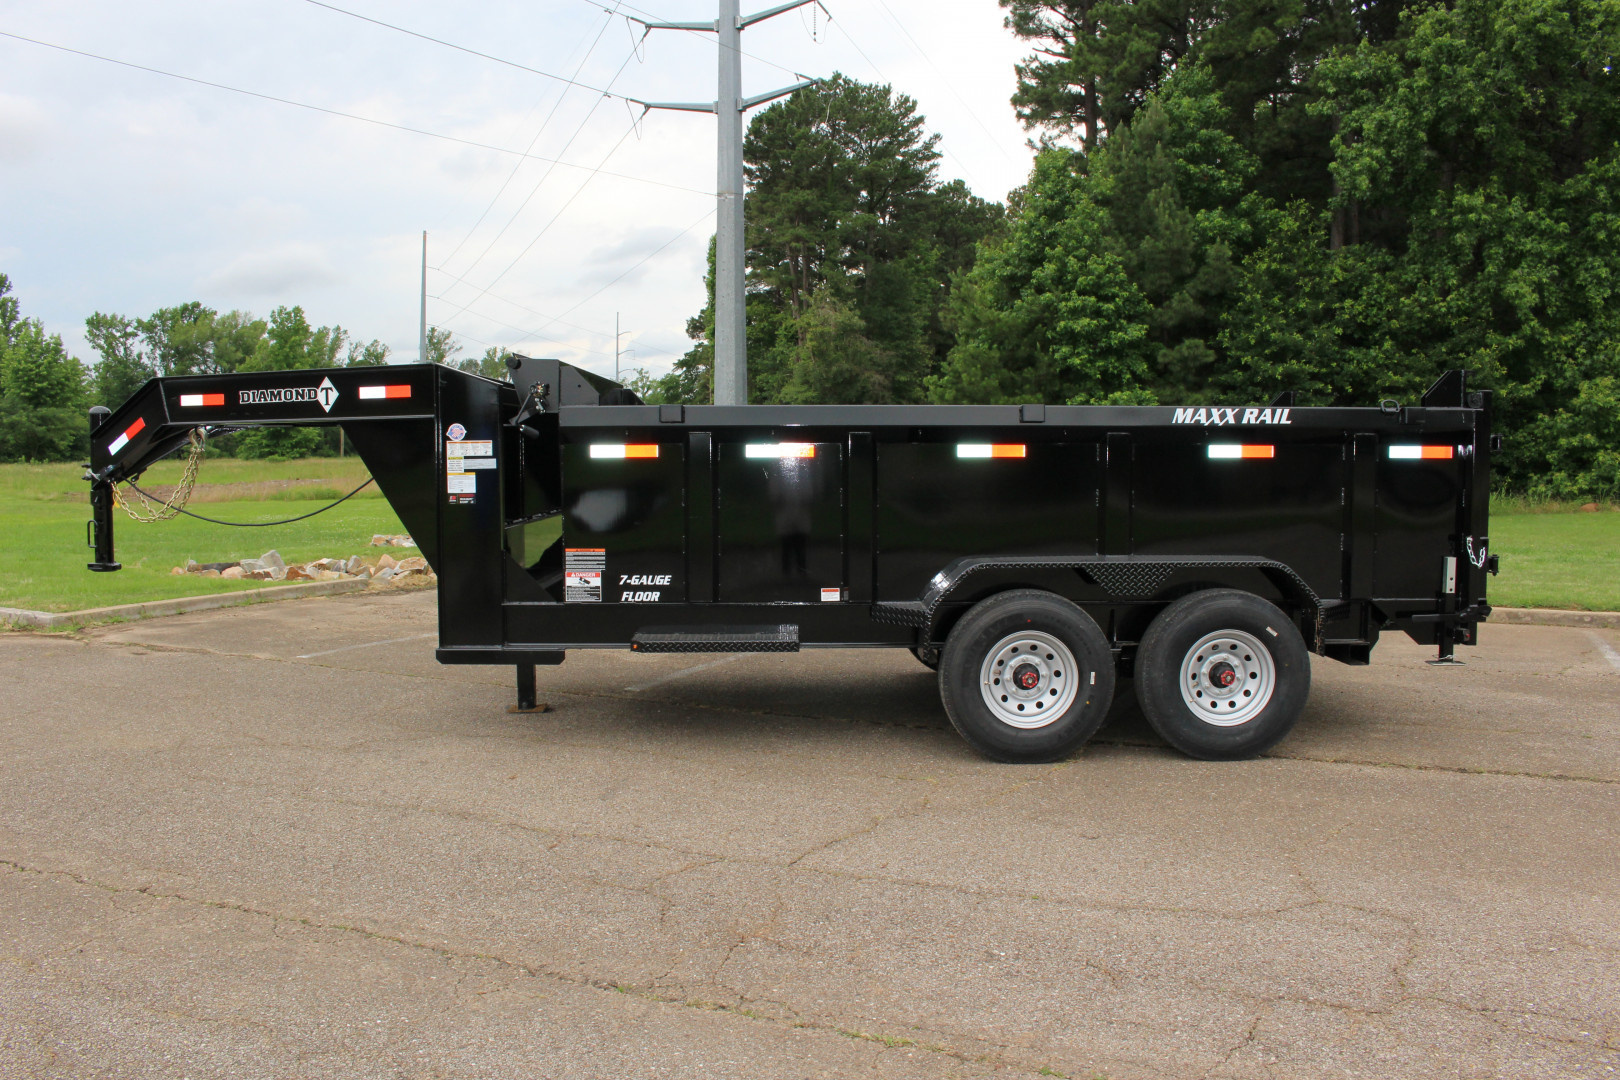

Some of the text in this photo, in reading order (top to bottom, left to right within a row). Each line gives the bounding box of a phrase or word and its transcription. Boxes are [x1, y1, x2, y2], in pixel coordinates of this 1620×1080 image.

[239, 387, 334, 406] DIAMOND T
[1171, 407, 1292, 427] MAXX RAIL
[619, 574, 672, 586] 7-GAUGE
[620, 591, 661, 602] FLOOR
